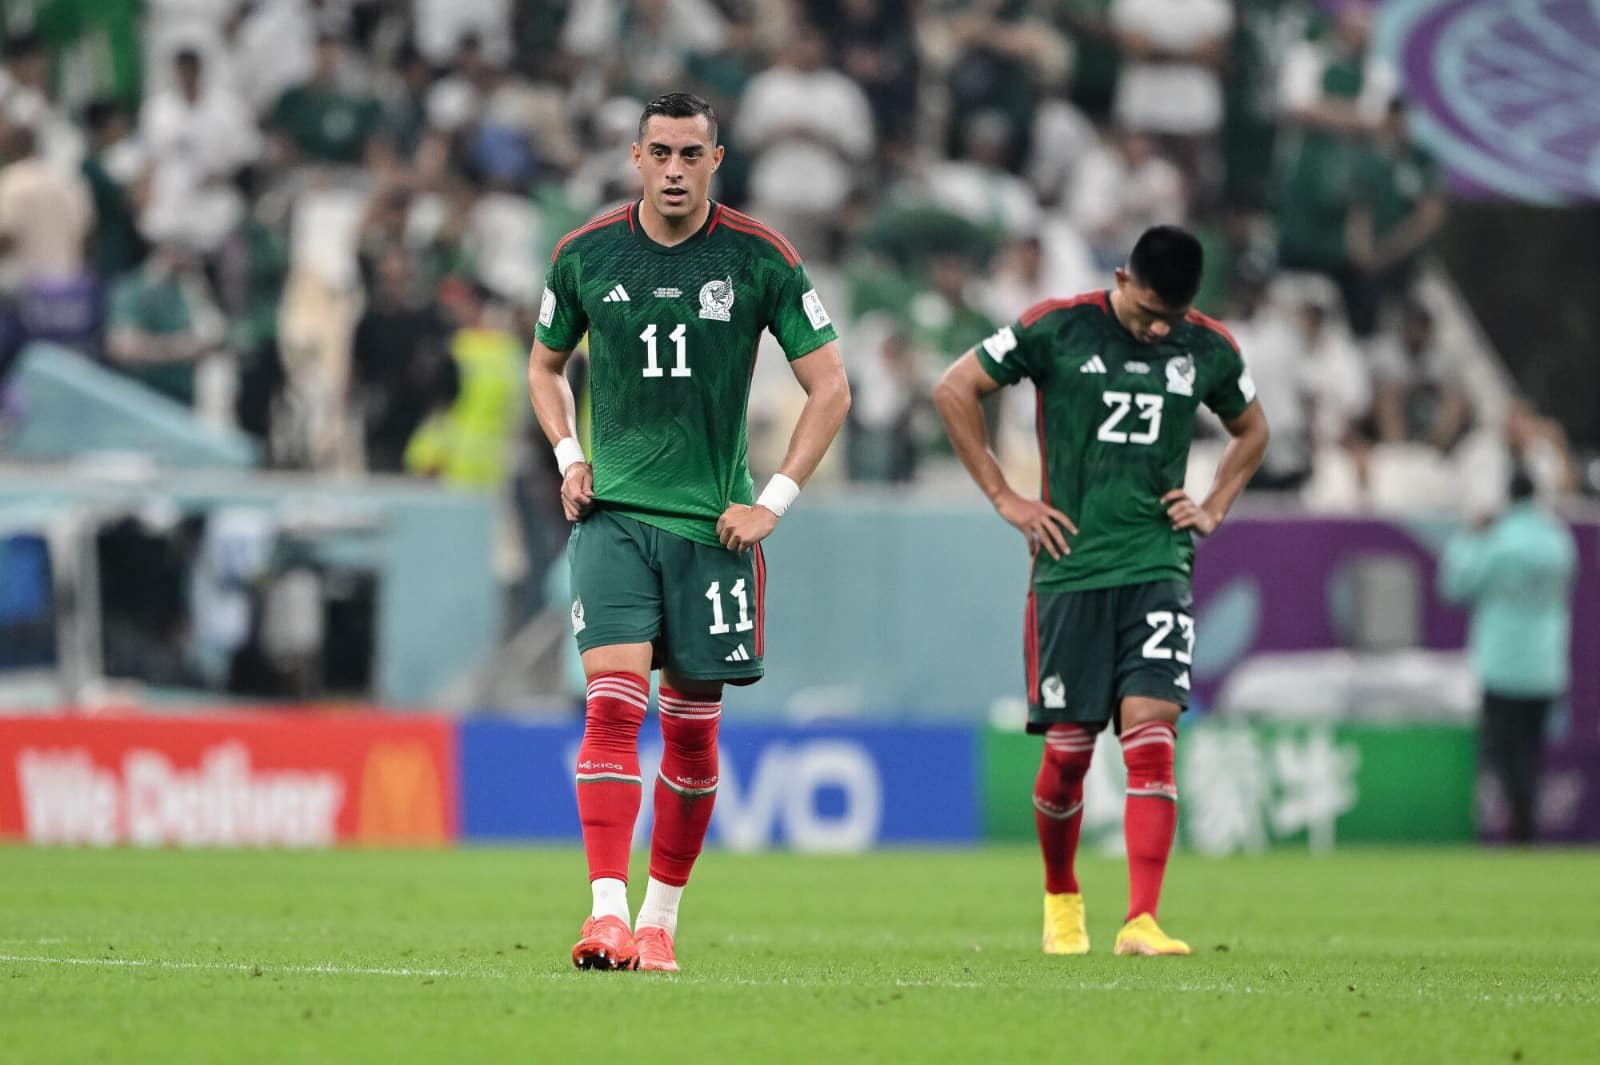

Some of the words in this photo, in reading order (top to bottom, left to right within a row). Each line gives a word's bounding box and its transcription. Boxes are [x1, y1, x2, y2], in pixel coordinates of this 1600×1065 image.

[639, 323, 691, 378] 11
[1097, 390, 1164, 445] 23
[704, 577, 754, 635] 11
[1142, 610, 1195, 666] 23
[16, 747, 118, 847] We
